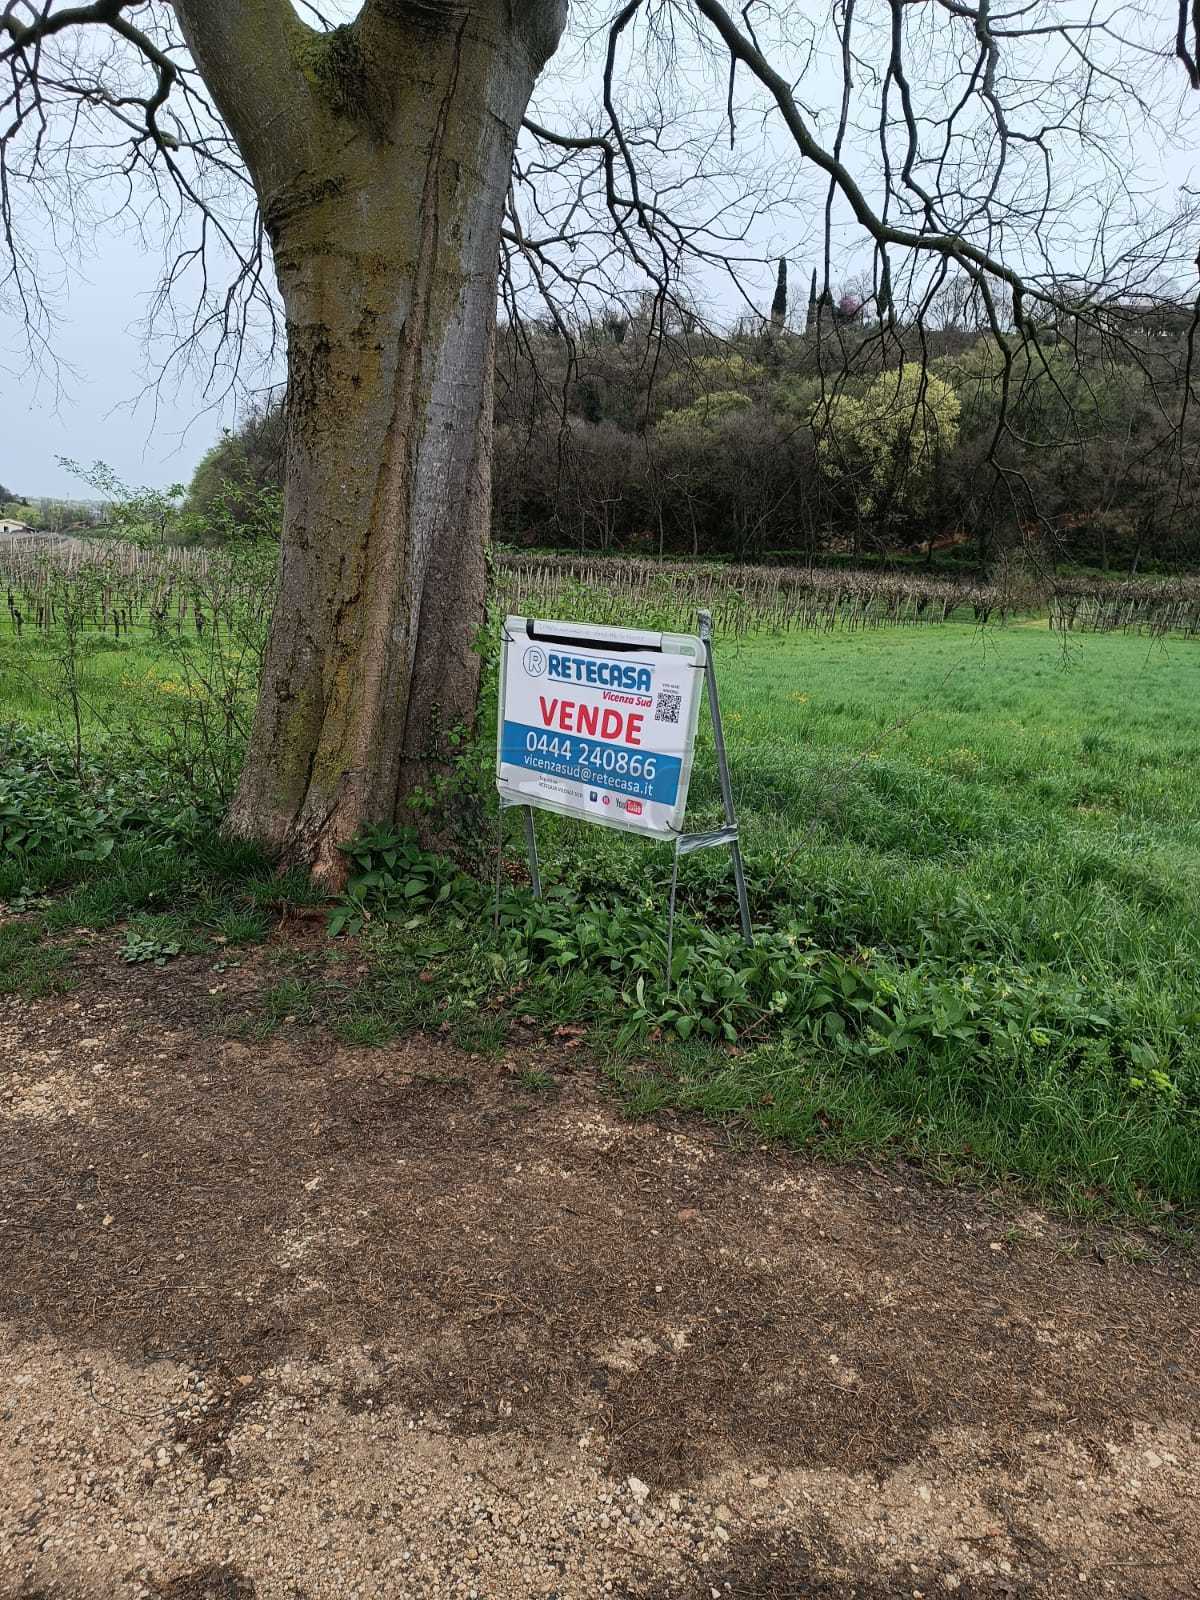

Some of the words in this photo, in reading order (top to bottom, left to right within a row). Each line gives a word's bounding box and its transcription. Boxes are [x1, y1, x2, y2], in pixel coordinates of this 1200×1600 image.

[548, 654, 652, 692] RETECASA
[602, 690, 634, 706] Vicenza
[634, 696, 653, 708] Sud
[539, 696, 644, 746] VENDE
[524, 754, 654, 797] vicenzasud@retecasa.it
[526, 731, 572, 761] 0444
[578, 743, 657, 780] 240866
